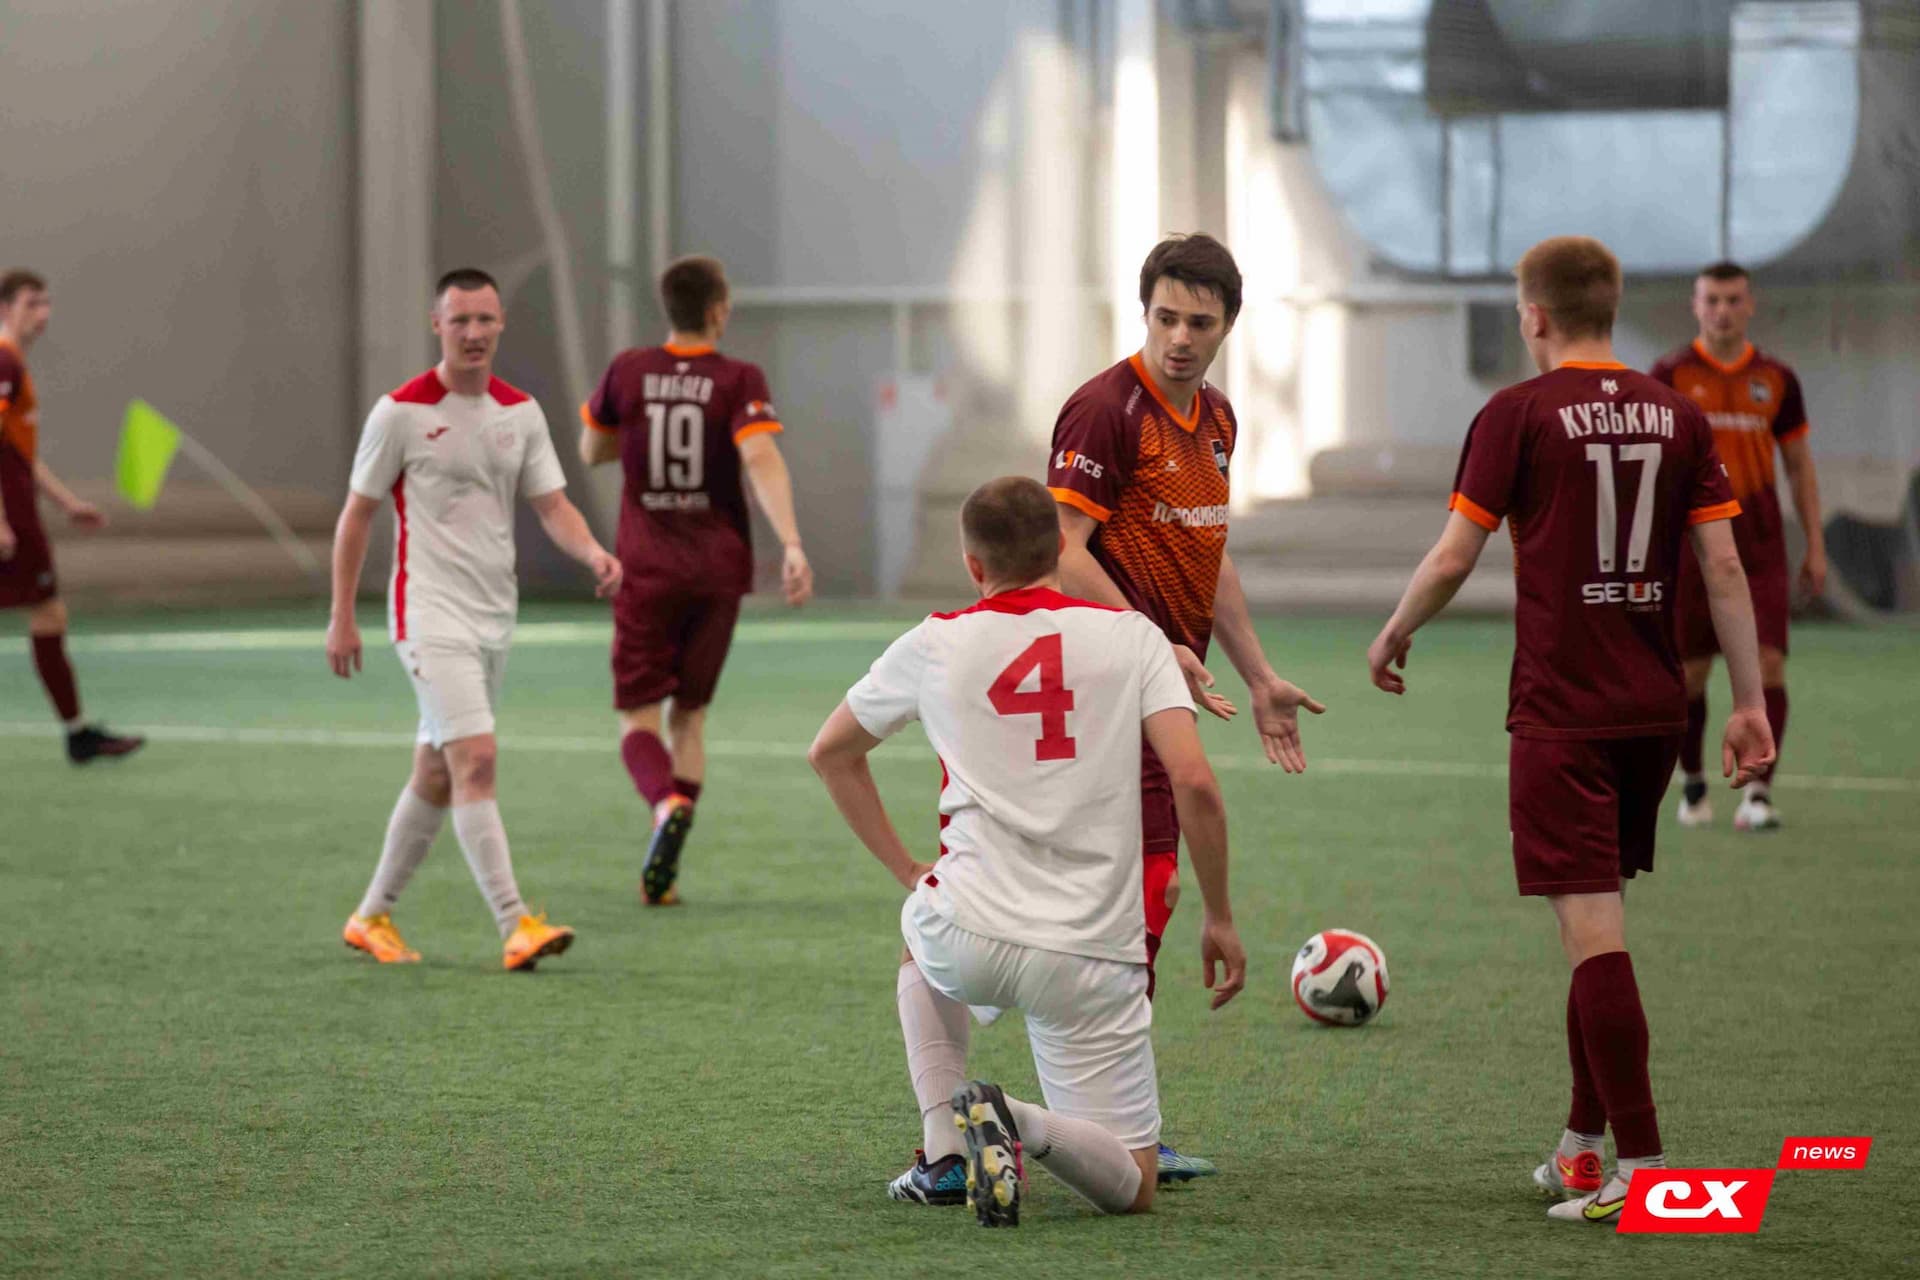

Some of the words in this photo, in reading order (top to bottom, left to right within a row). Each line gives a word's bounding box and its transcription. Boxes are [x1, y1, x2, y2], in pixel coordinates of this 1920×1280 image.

[644, 403, 705, 490] 19
[1558, 401, 1675, 439] КУЗЬКИН
[1072, 454, 1105, 479] ПСБ
[1585, 442, 1663, 573] 17
[1582, 581, 1663, 604] SEUS
[986, 632, 1077, 761] 4
